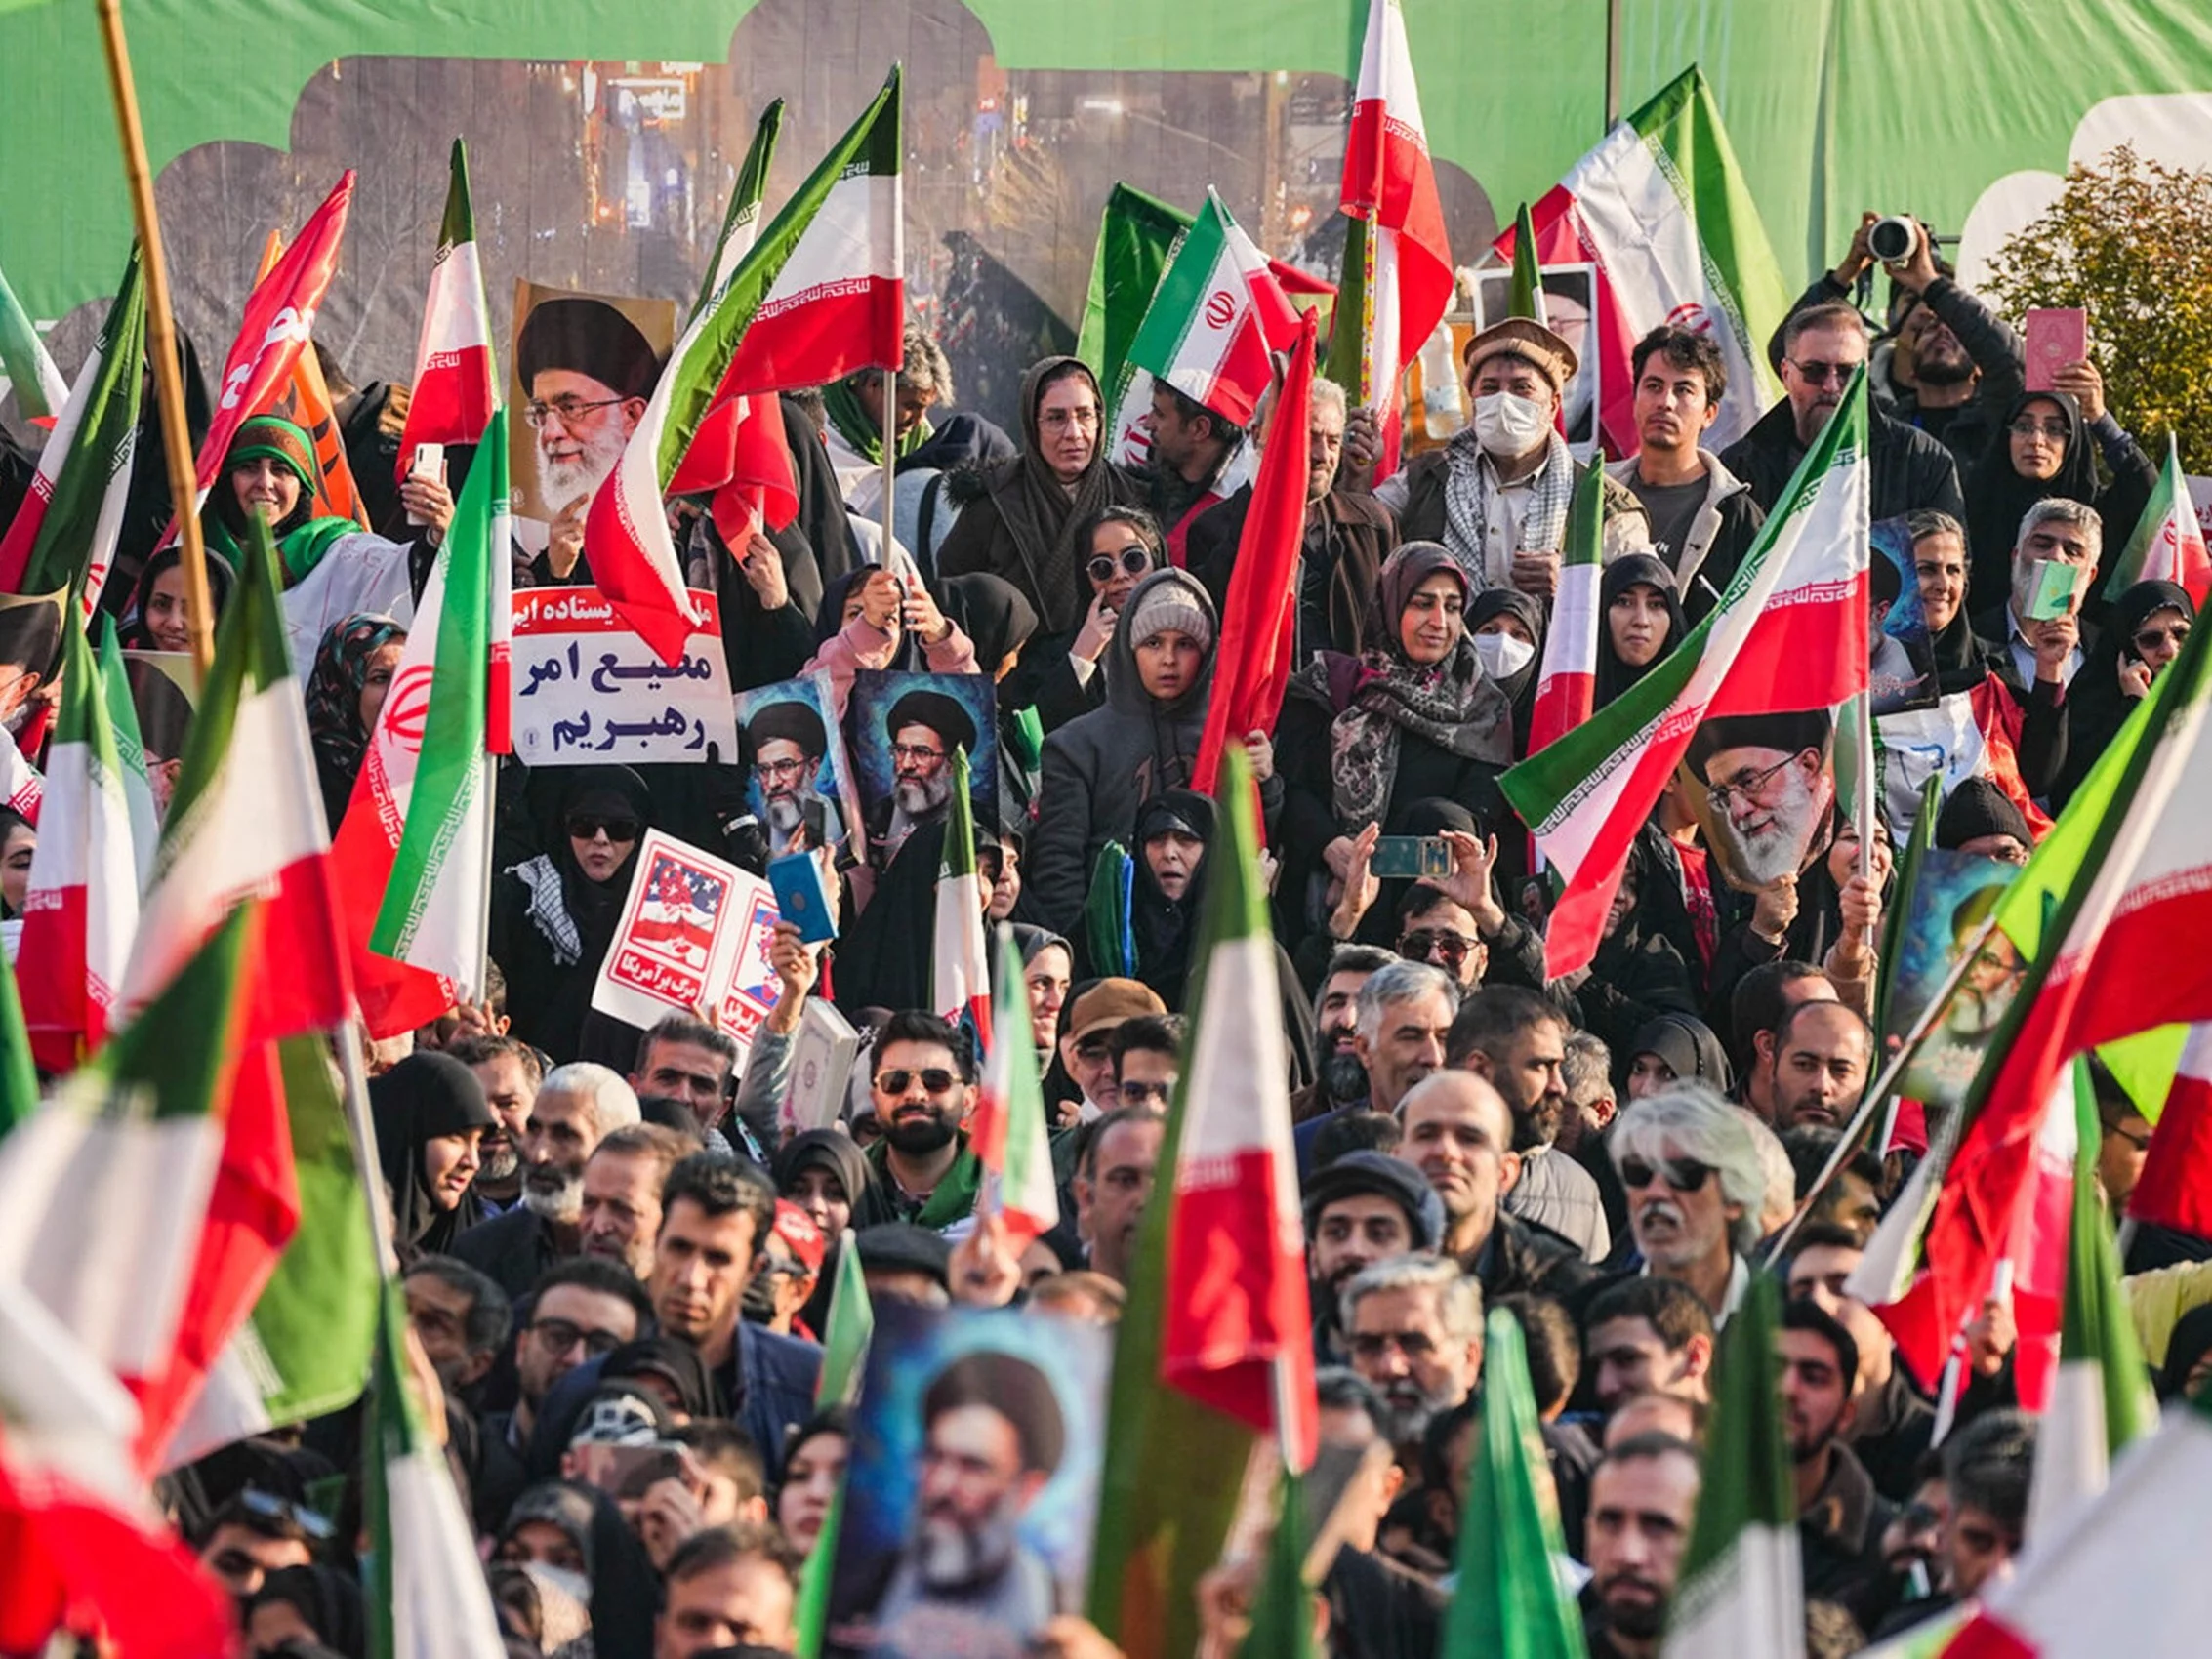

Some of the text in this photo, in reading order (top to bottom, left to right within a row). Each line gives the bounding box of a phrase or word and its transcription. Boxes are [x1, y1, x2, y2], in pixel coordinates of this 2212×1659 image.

[543, 594, 621, 626] یستاده
[519, 640, 580, 696] امر
[553, 706, 705, 752] رهبریم
[620, 952, 665, 983] آمریکا
[654, 975, 673, 991] بر
